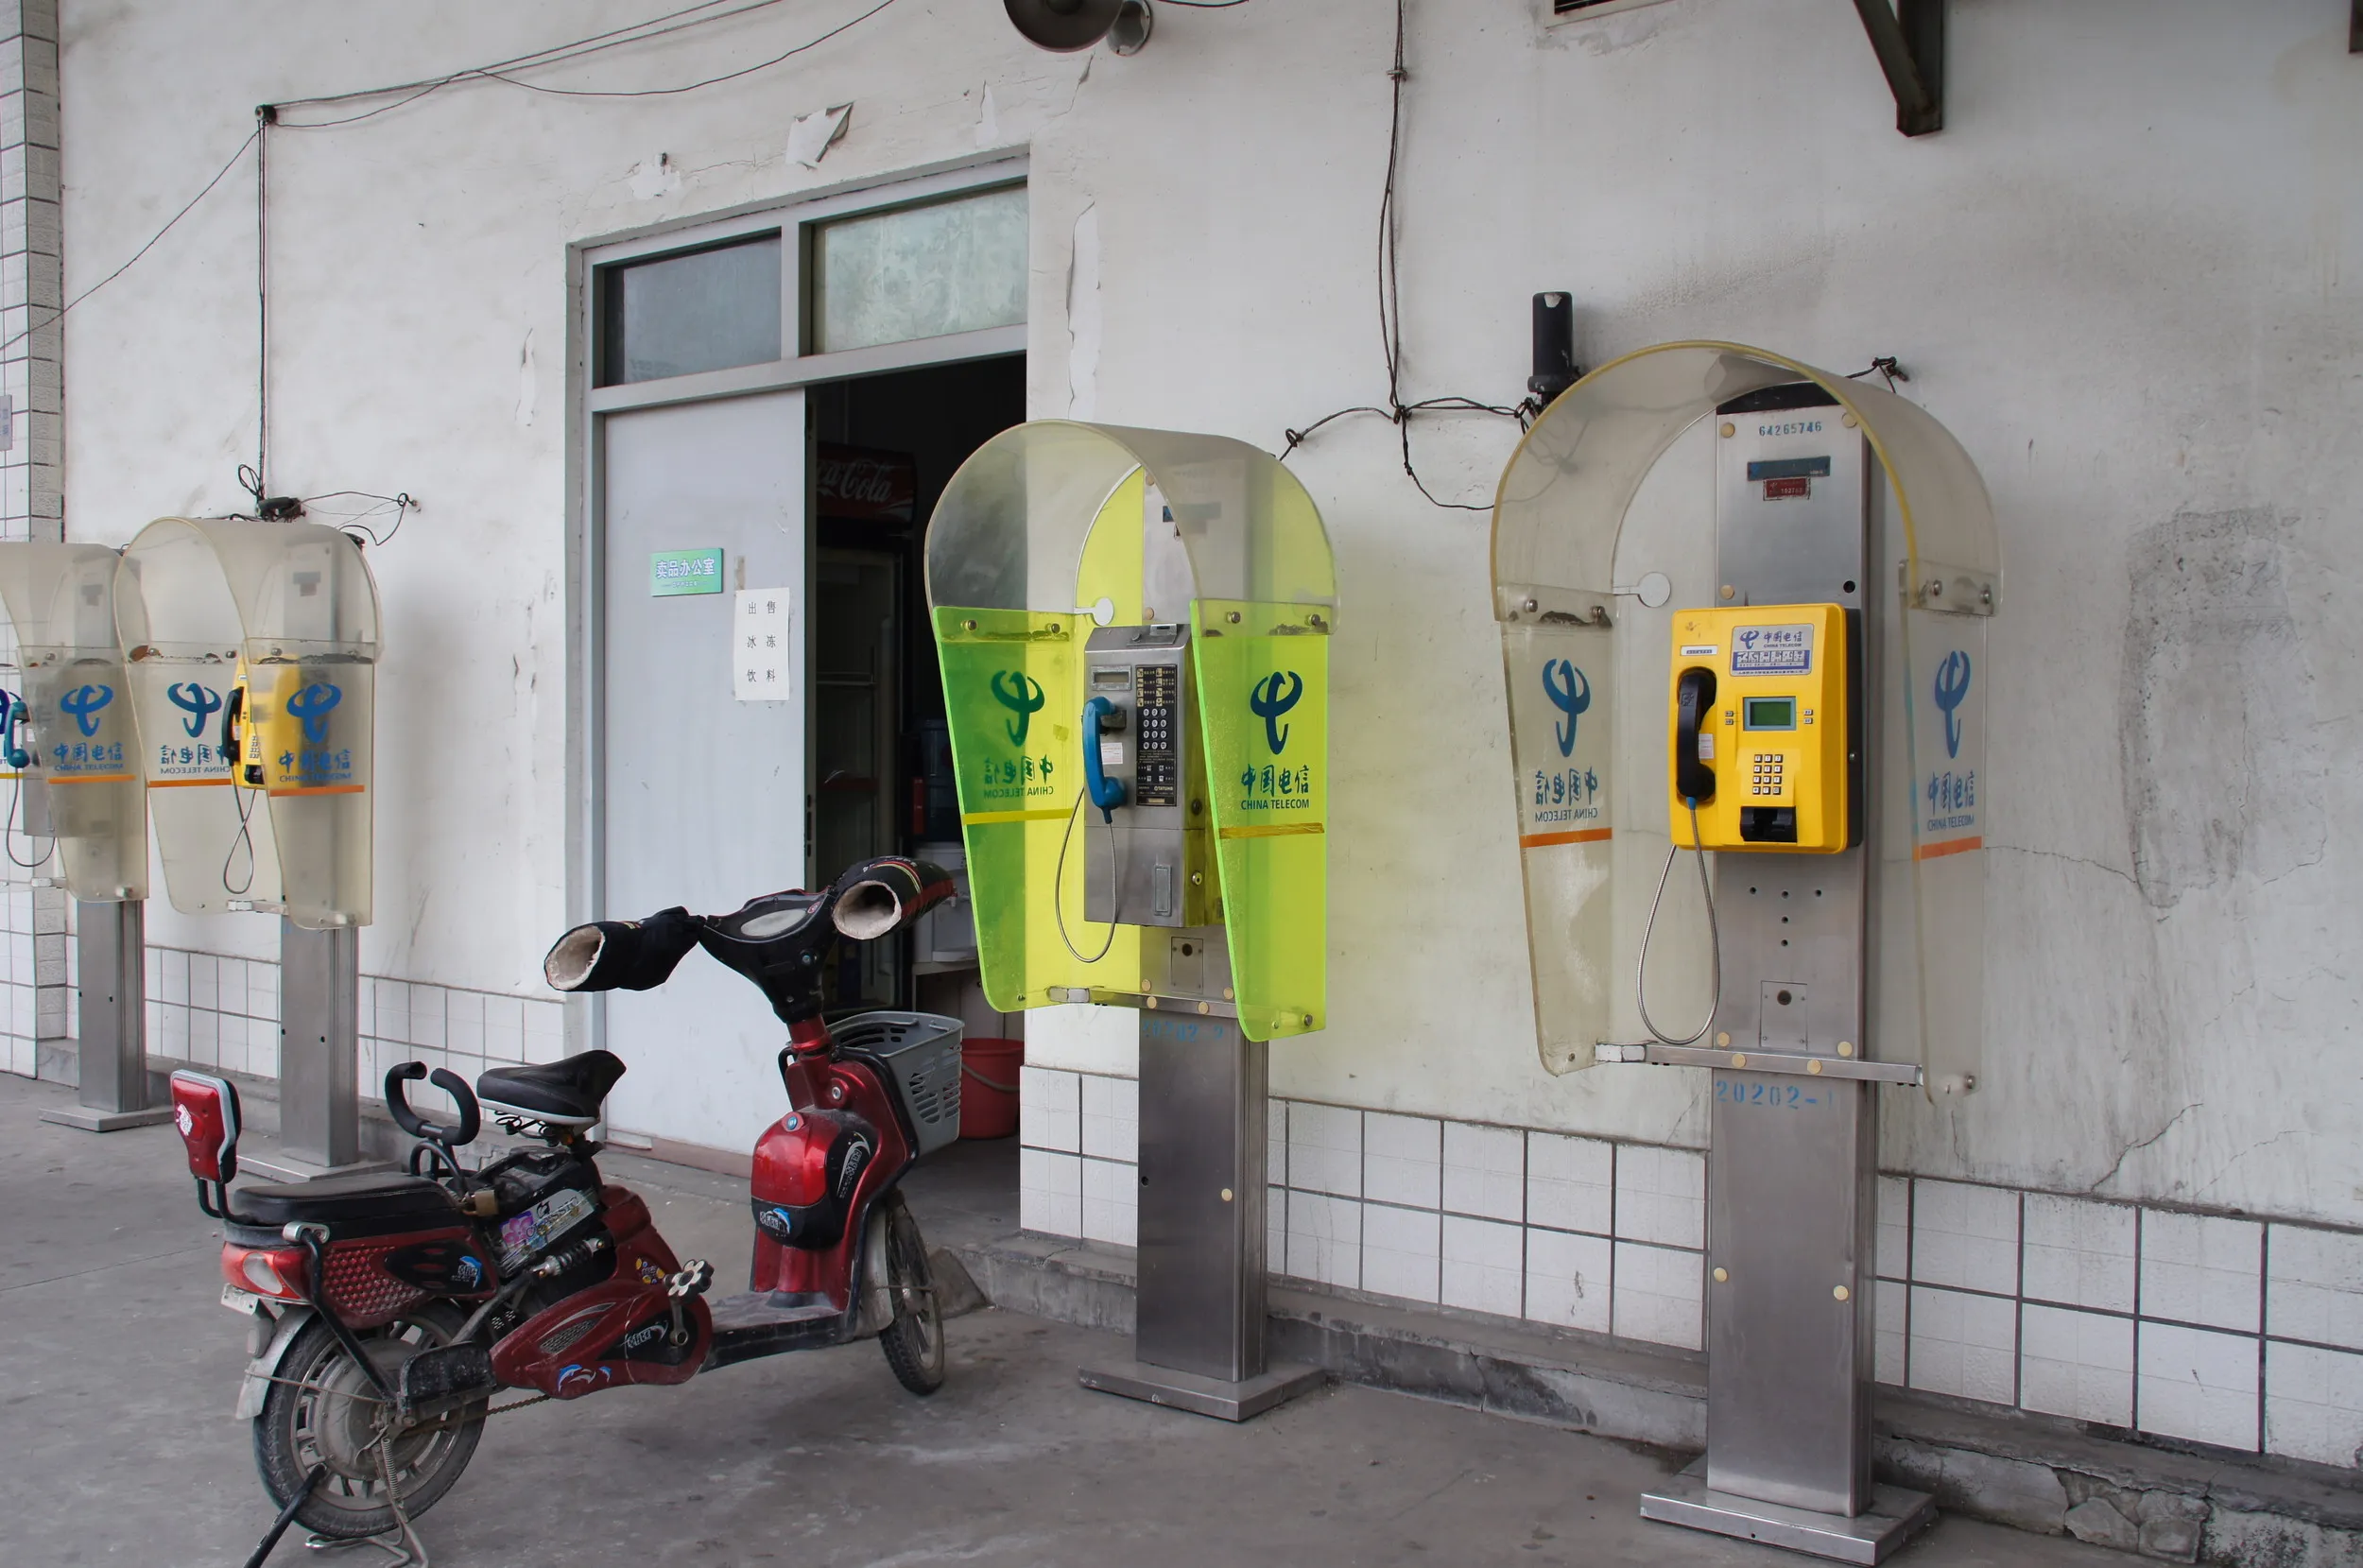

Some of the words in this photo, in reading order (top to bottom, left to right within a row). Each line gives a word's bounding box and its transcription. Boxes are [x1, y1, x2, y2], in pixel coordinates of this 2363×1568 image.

[1759, 422, 1822, 437] 64265746
[656, 557, 716, 579] 卖品办公室
[748, 600, 776, 614] 出售
[747, 634, 776, 649] 冰冻
[1764, 630, 1802, 643] 中国电信
[747, 668, 776, 682] 饮料
[53, 742, 123, 763] 中国电信
[1241, 764, 1309, 798] 中国电信
[1928, 769, 1975, 817] 中国电信
[1241, 800, 1268, 810] CHINA
[1270, 799, 1309, 809] TELECOM
[1927, 818, 1946, 831] CHINA
[1947, 815, 1975, 828] TELECOM
